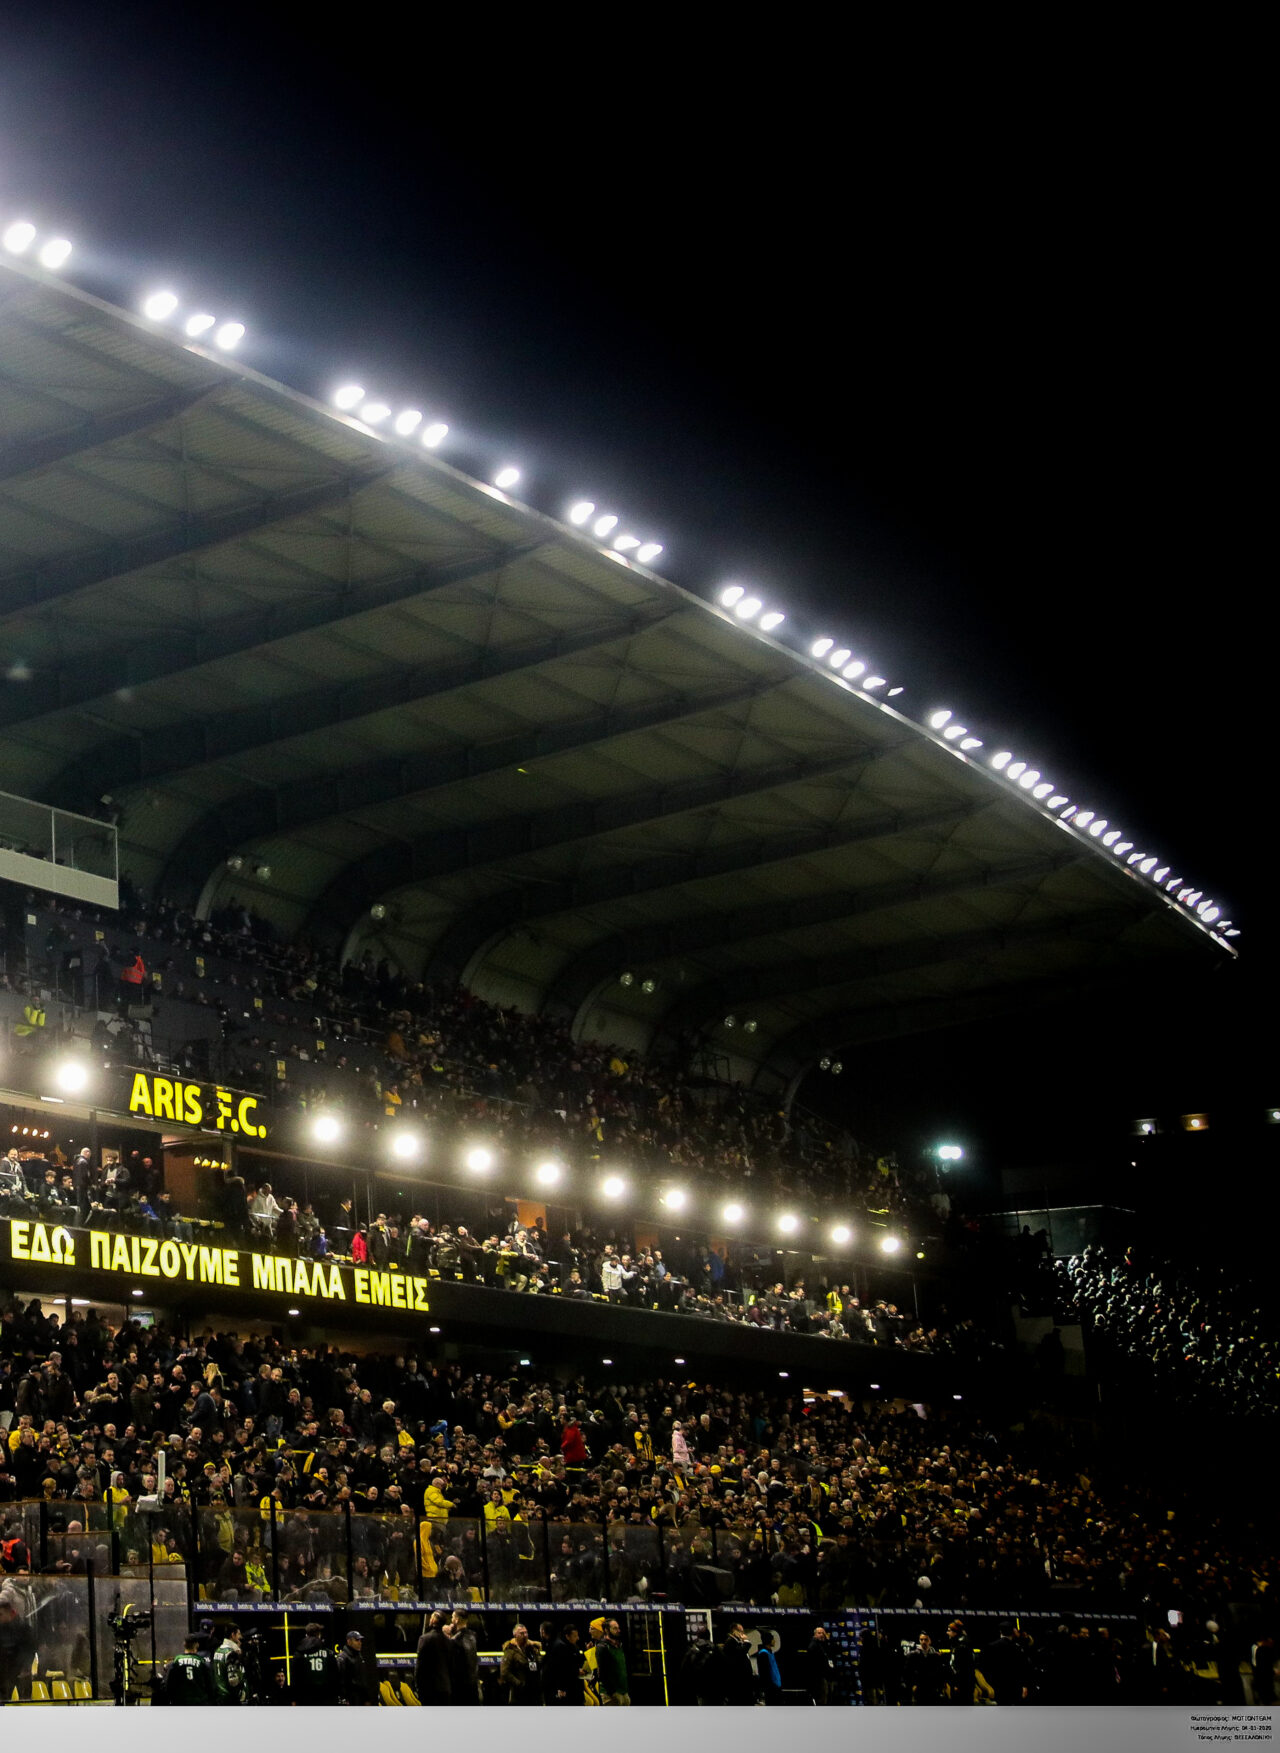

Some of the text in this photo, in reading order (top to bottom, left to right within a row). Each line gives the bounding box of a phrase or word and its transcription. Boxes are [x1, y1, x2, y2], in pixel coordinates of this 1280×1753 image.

[129, 1073, 267, 1139] ARIS F.C.
[10, 1219, 430, 1312] ΕΔΩ ΠΑΙΖΟΥΜΕ ΜΠΑΛΑ ΕΜΕΙΣ
[178, 1657, 201, 1668] STAFF
[309, 1658, 323, 1671] 16
[186, 1666, 194, 1680] 5
